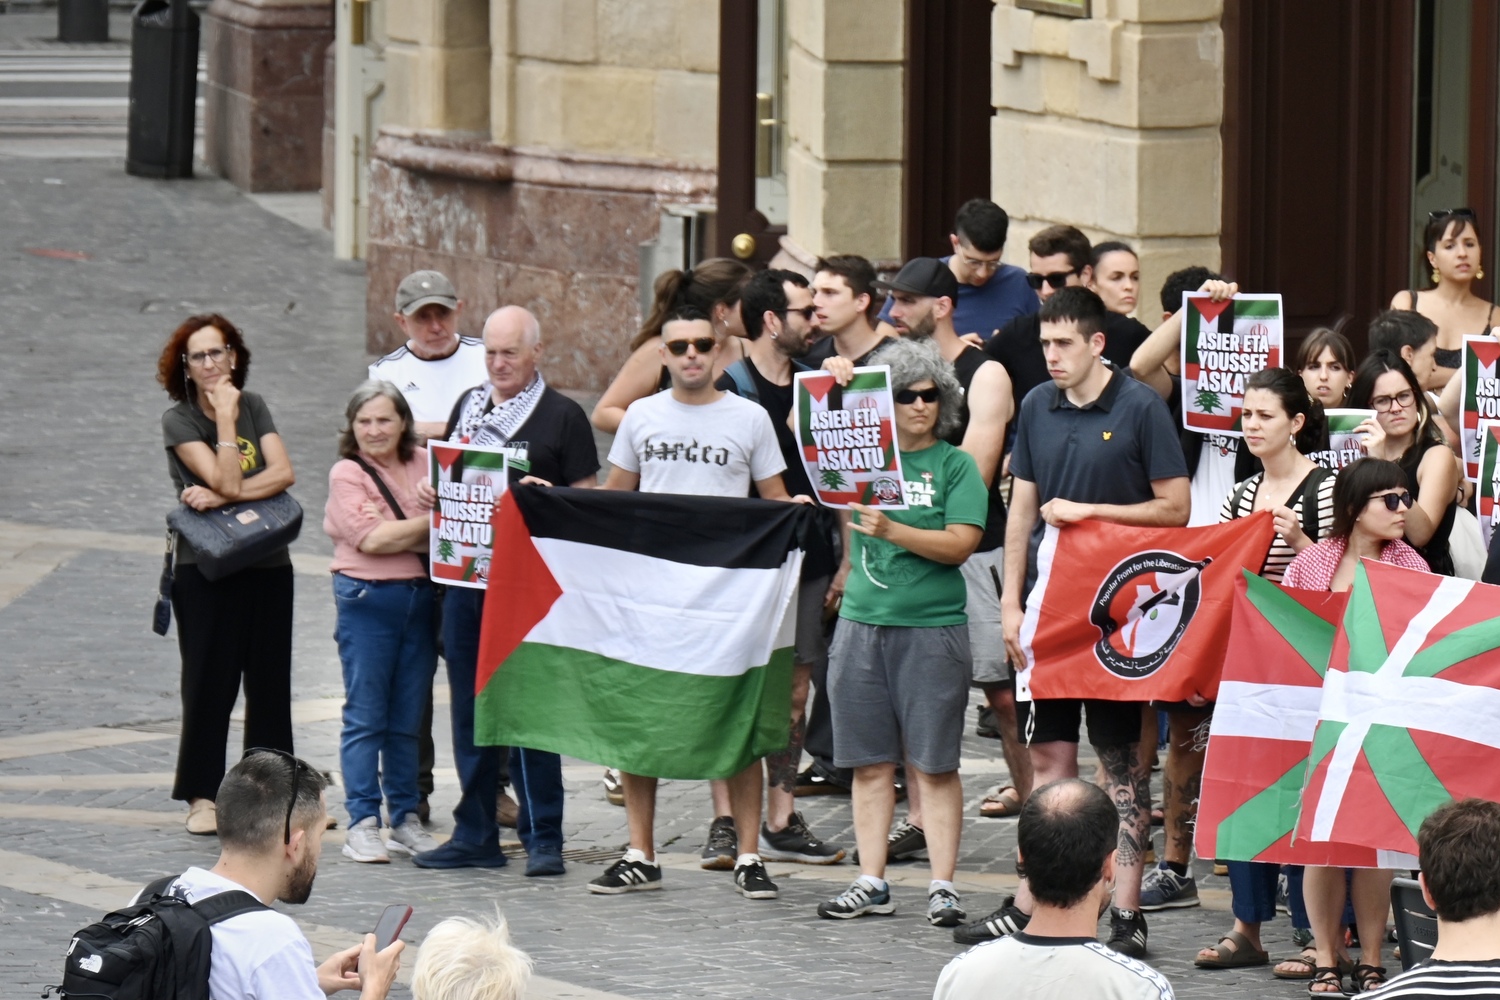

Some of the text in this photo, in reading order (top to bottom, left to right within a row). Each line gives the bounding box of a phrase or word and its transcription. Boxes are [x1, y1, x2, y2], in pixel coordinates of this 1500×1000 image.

[1196, 331, 1269, 353] ASIER ETA
[1197, 350, 1268, 373] YOUSSEF
[1197, 371, 1250, 395] ASKA
[810, 407, 881, 431] ASIER ETA
[811, 427, 882, 450] YOUSSEF
[818, 447, 885, 472] ASKATU
[437, 480, 494, 504] ASIER ETA
[440, 498, 494, 523] YOUSSEF
[438, 518, 493, 546] ASKATU
[1099, 580, 1118, 606] Popular
[1116, 566, 1134, 582] Front
[1132, 562, 1143, 571] for
[1143, 559, 1155, 568] the
